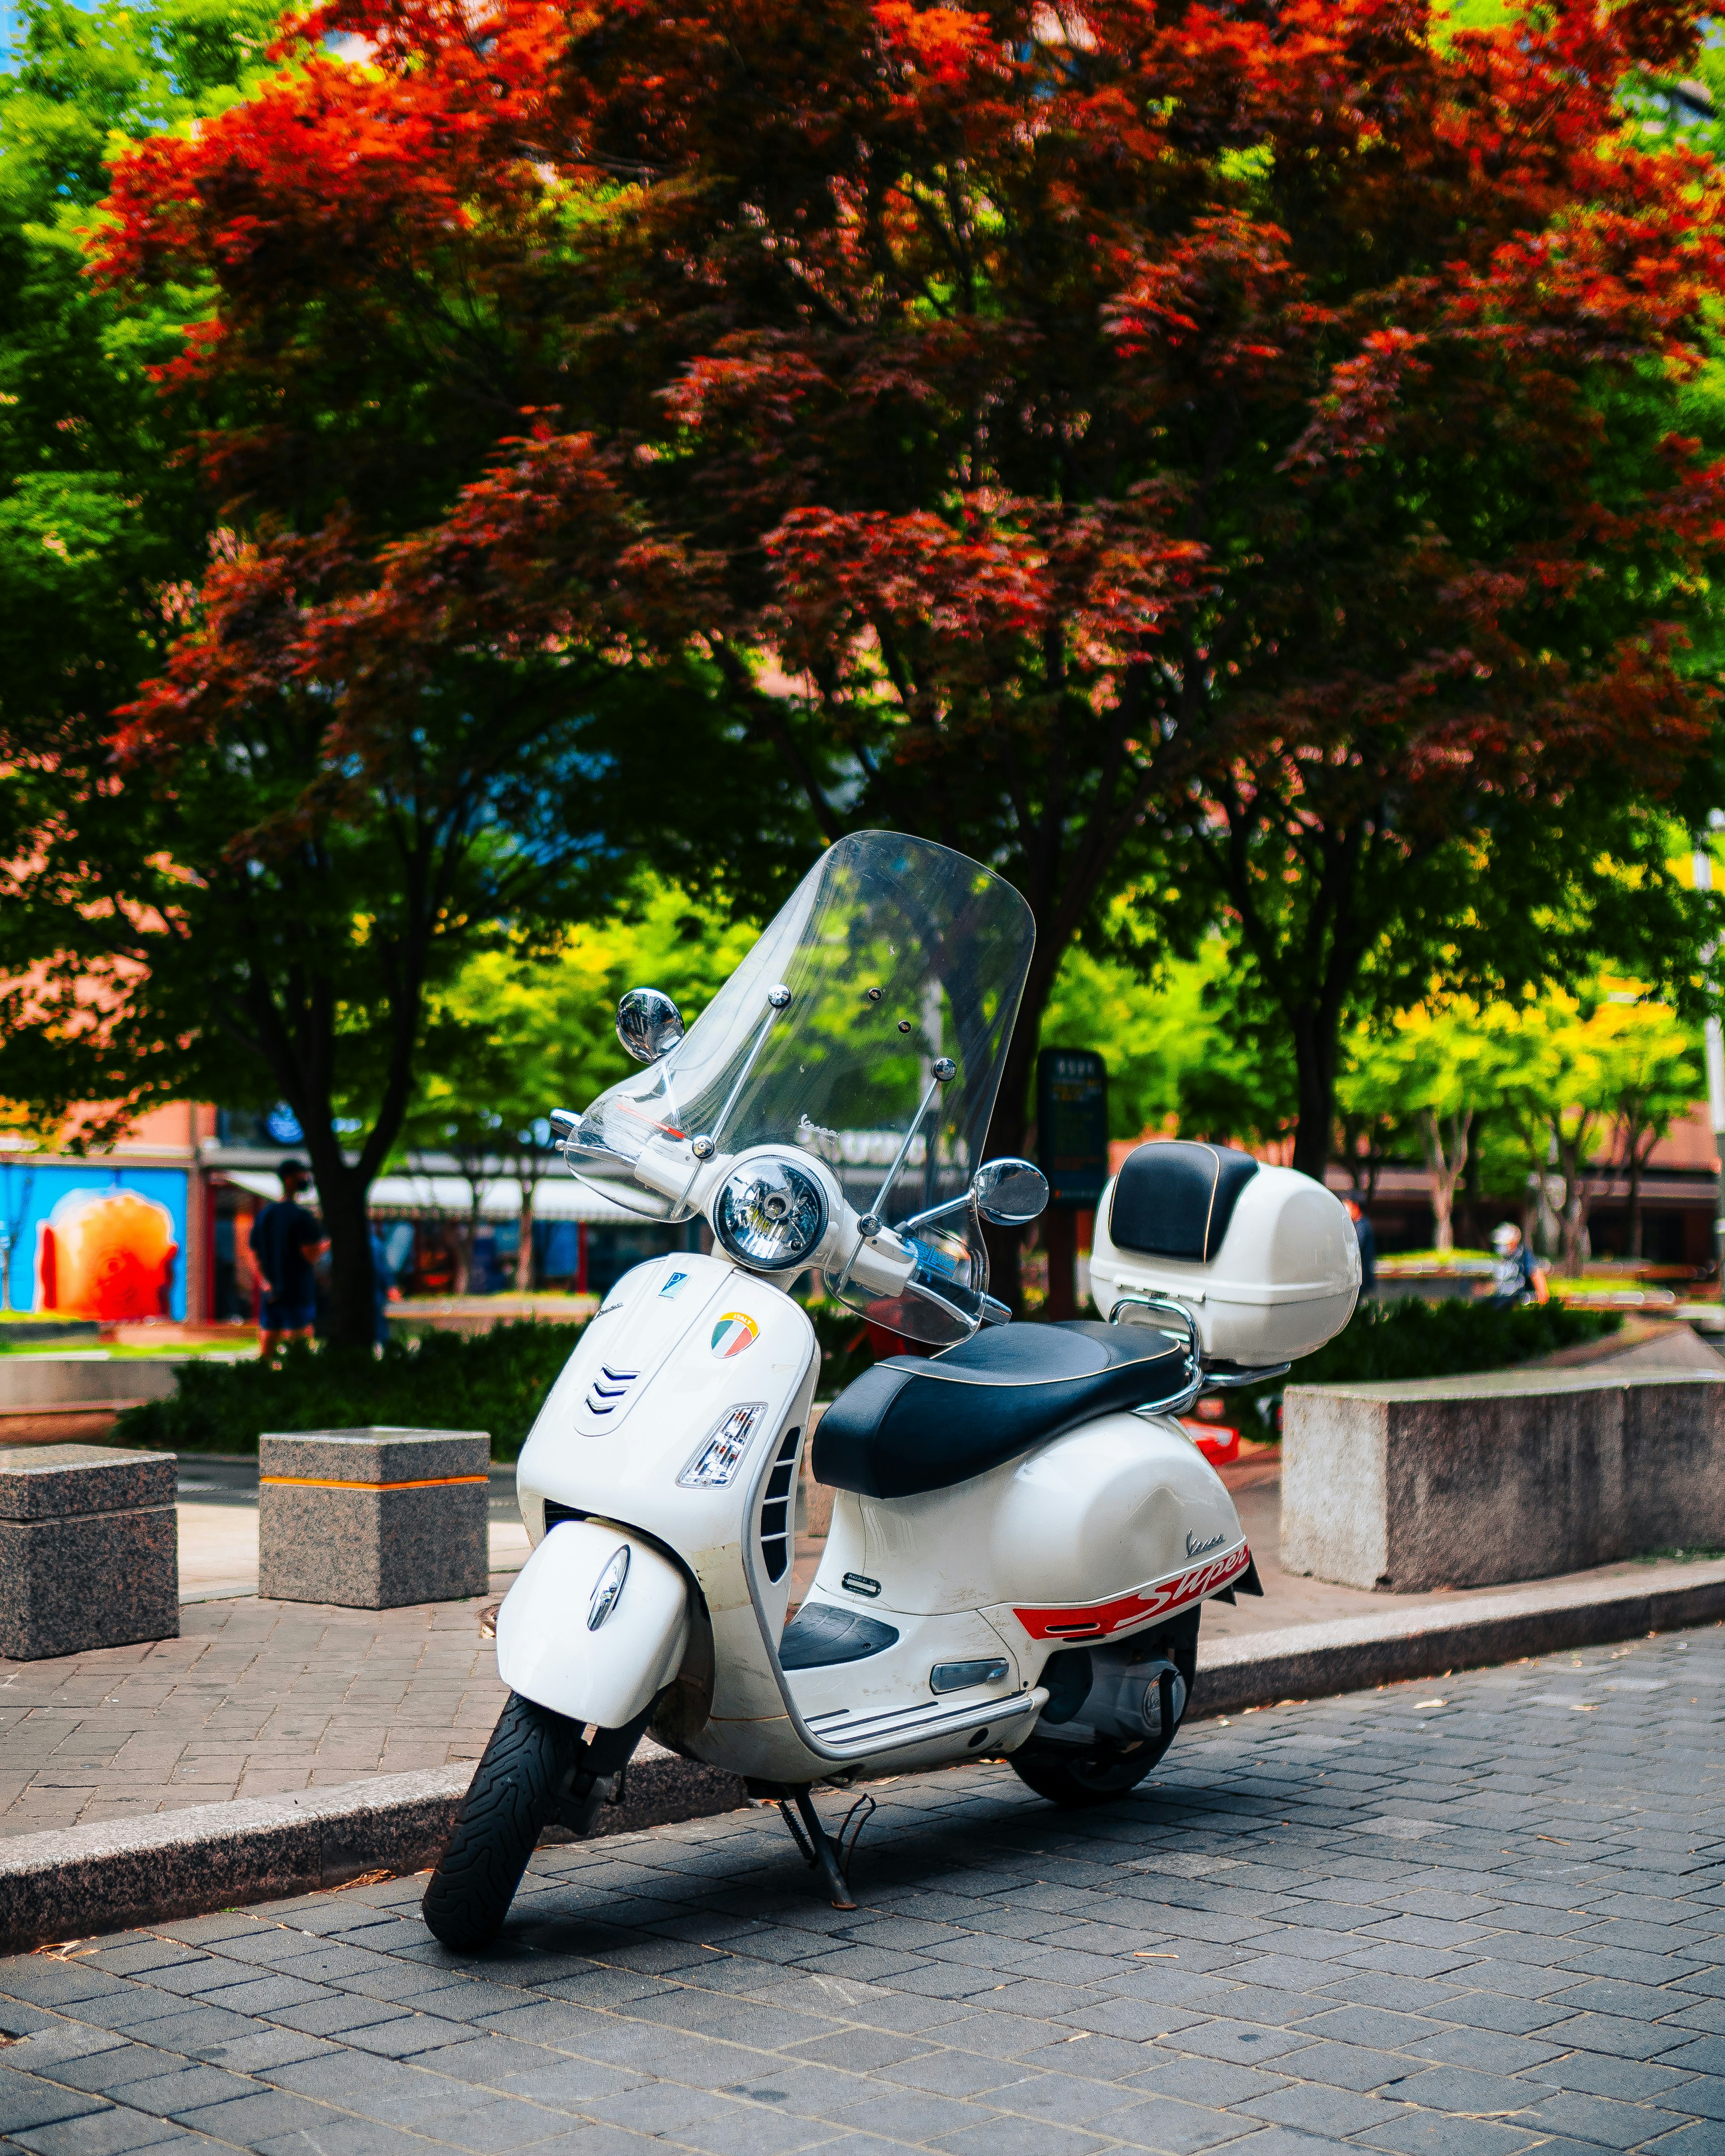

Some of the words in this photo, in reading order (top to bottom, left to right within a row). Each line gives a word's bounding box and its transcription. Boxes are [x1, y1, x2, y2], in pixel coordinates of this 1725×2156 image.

[798, 1114, 839, 1138] Vespa
[733, 1314, 752, 1325] ITALY
[1184, 1527, 1226, 1560] Vespa
[1113, 1548, 1247, 1629] Super
